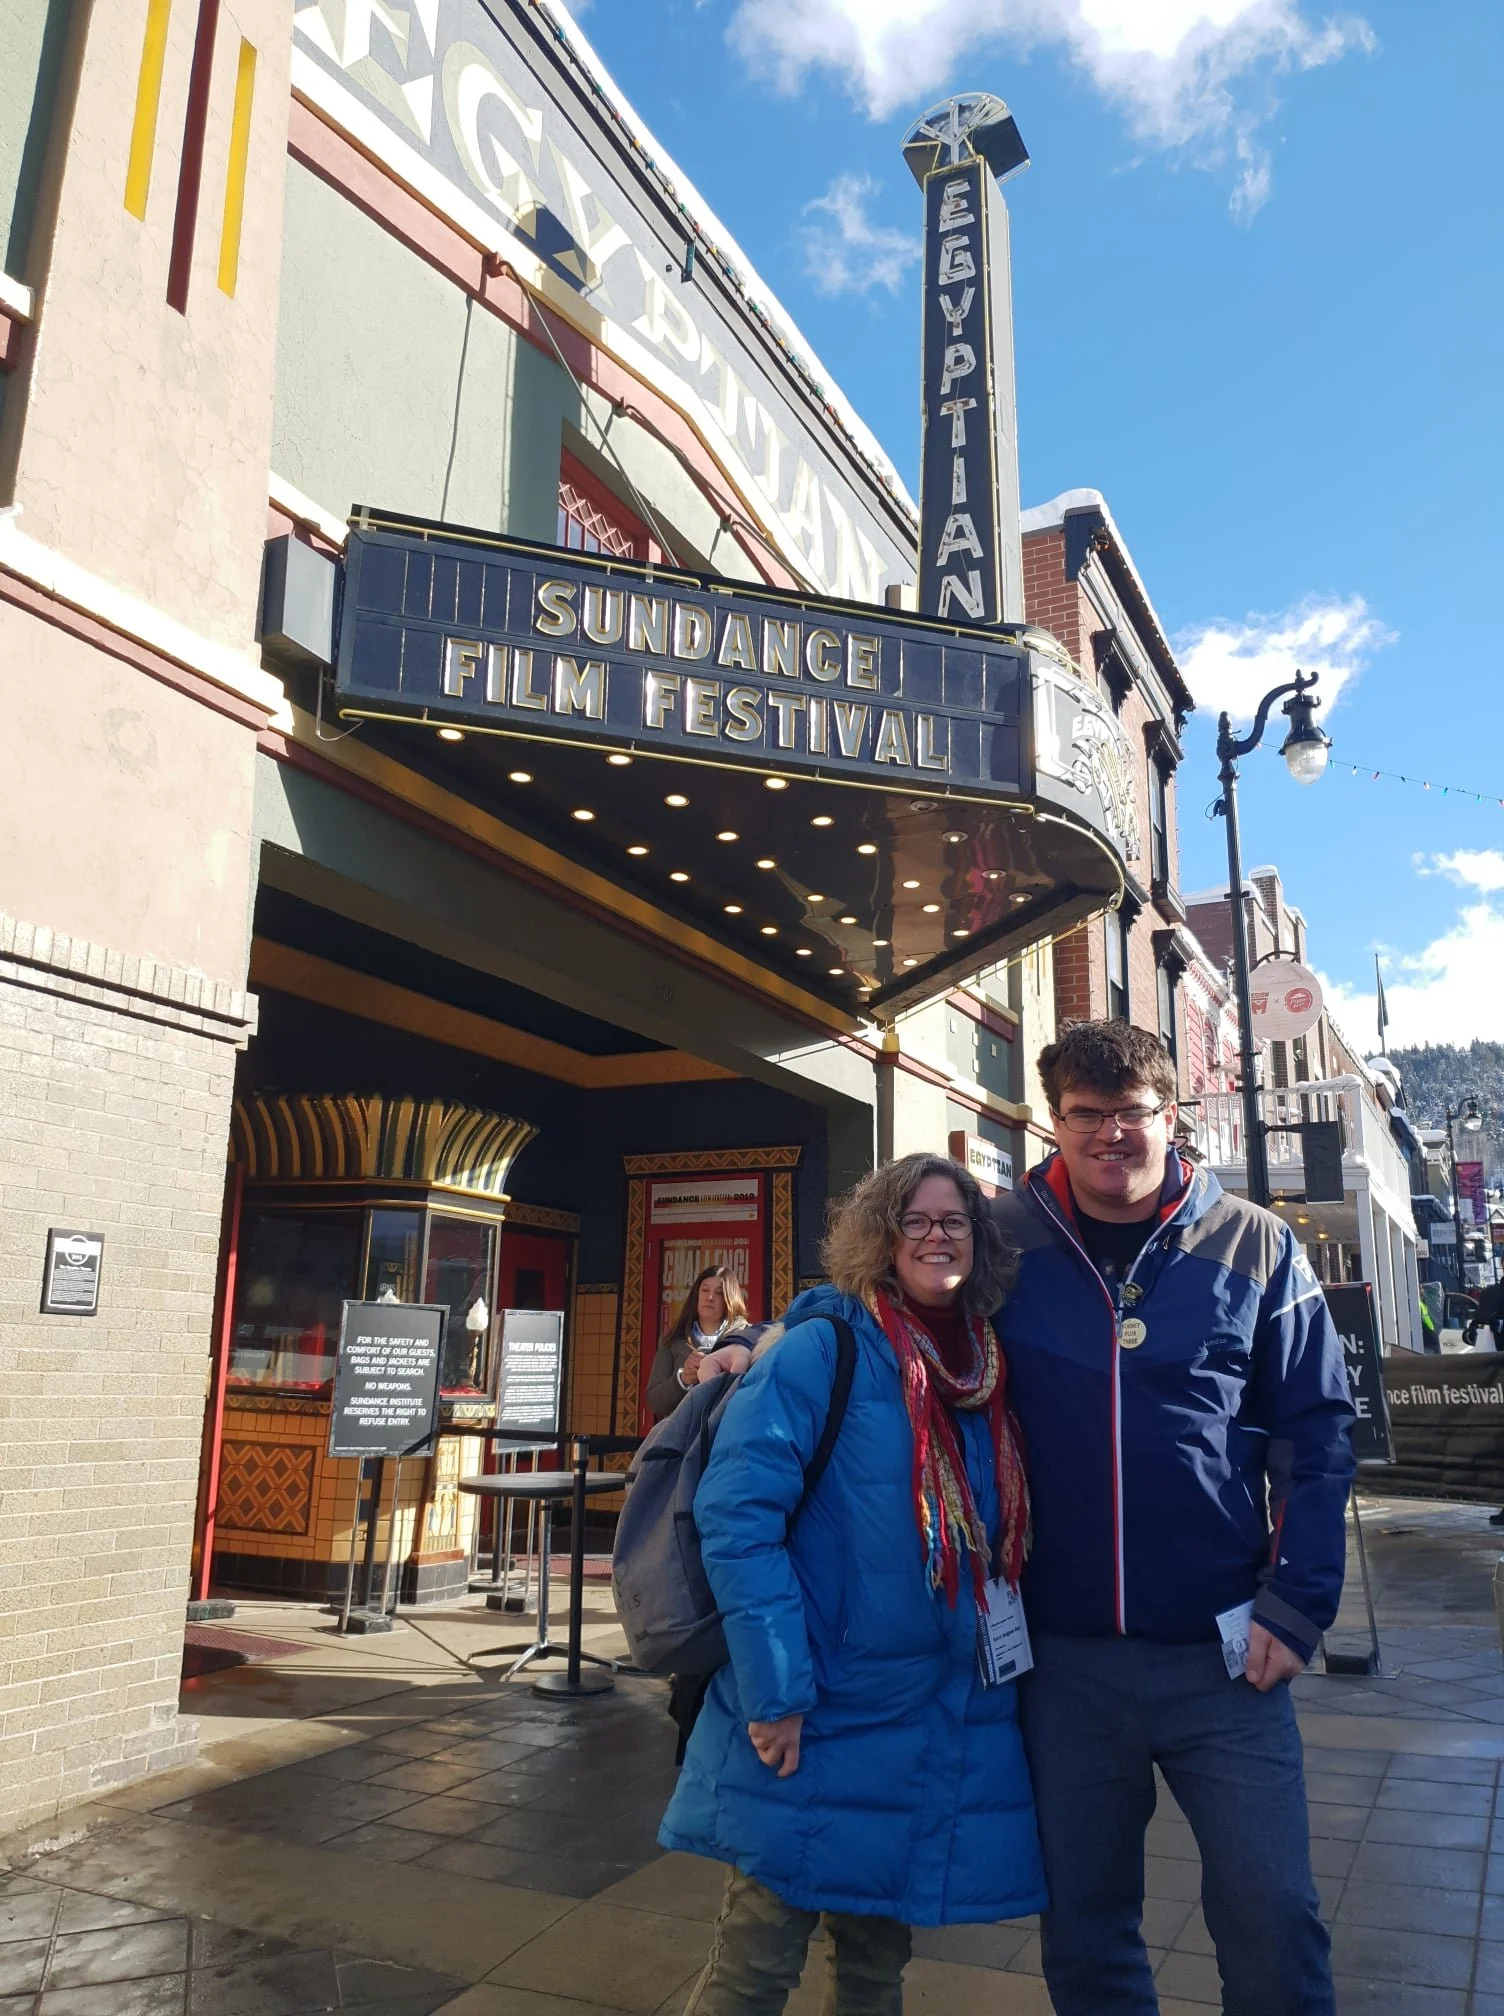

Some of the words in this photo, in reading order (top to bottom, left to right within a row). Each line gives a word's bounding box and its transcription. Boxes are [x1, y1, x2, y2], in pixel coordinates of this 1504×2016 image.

[936, 180, 985, 618] EGYPTIAN
[536, 580, 880, 691] SUNDANCE
[443, 637, 605, 720] FILM
[645, 670, 949, 771] FESTIVAL
[970, 1148, 1012, 1179] EGYPTIAN
[656, 1195, 700, 1205] SUNDANCE
[357, 1335, 372, 1344] FOR
[373, 1336, 388, 1345] THE
[388, 1337, 414, 1346] SAFETY
[414, 1338, 430, 1347] AND
[508, 1341, 534, 1352] THEATER
[534, 1342, 557, 1352] POLICIES
[346, 1345, 381, 1354] COMFORT
[381, 1347, 392, 1355] OF
[392, 1347, 408, 1356] OUR
[350, 1355, 370, 1364] BAGS
[371, 1356, 387, 1365] AND
[387, 1357, 417, 1366] JACKETS
[417, 1358, 431, 1366] ARE
[354, 1365, 386, 1374] SUBJECT
[386, 1367, 397, 1375] TO
[396, 1367, 425, 1376] SEARCH.
[364, 1381, 377, 1390] NO
[377, 1382, 413, 1391] WEAPONS.
[1411, 1384, 1442, 1405] film
[1442, 1382, 1504, 1405] festival
[350, 1396, 389, 1406] SUNDANCE
[389, 1397, 423, 1406] INSTITUTE
[343, 1406, 380, 1415] RESERVES
[380, 1407, 396, 1416] THE
[395, 1407, 417, 1416] RIGHT
[417, 1408, 427, 1416] TO
[358, 1417, 386, 1425] REFUSE
[386, 1417, 411, 1426] ENTRY.
